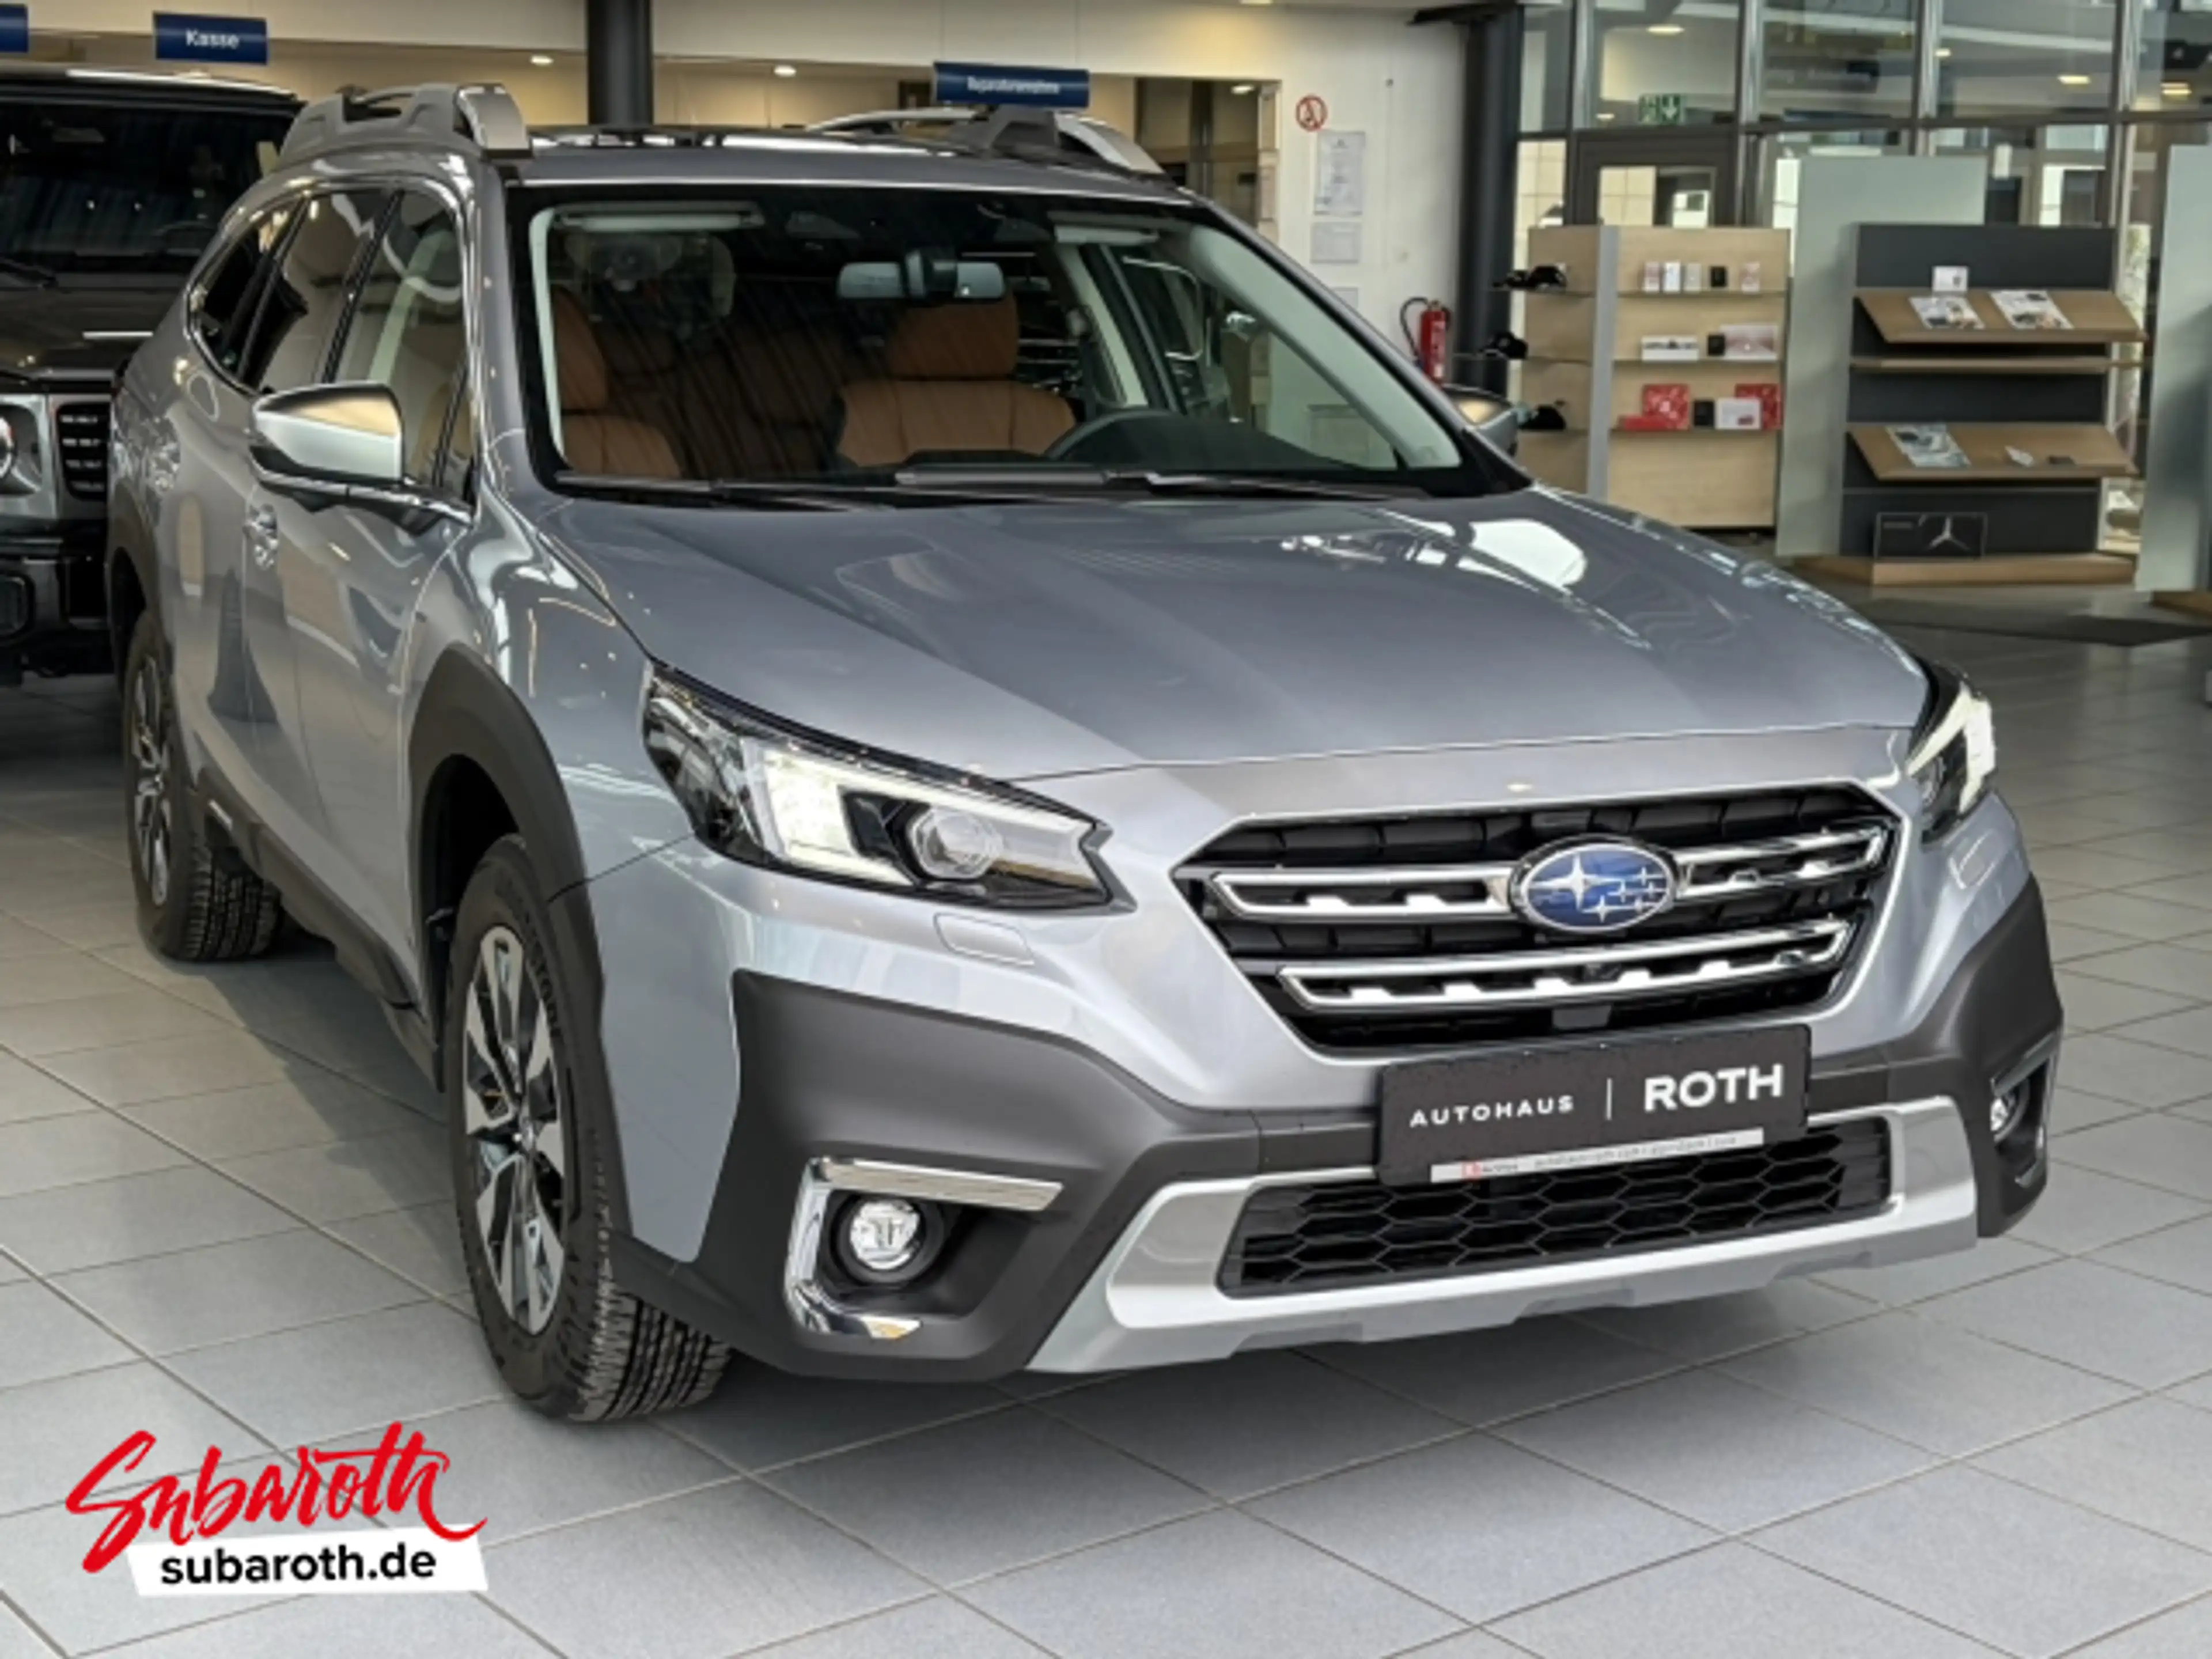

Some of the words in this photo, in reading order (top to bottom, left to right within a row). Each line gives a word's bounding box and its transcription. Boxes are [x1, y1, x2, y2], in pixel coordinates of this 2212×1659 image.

[185, 29, 240, 48] Kasse
[1410, 1095, 1573, 1128] AUTOHAUS
[1645, 1063, 1783, 1112] ROTH
